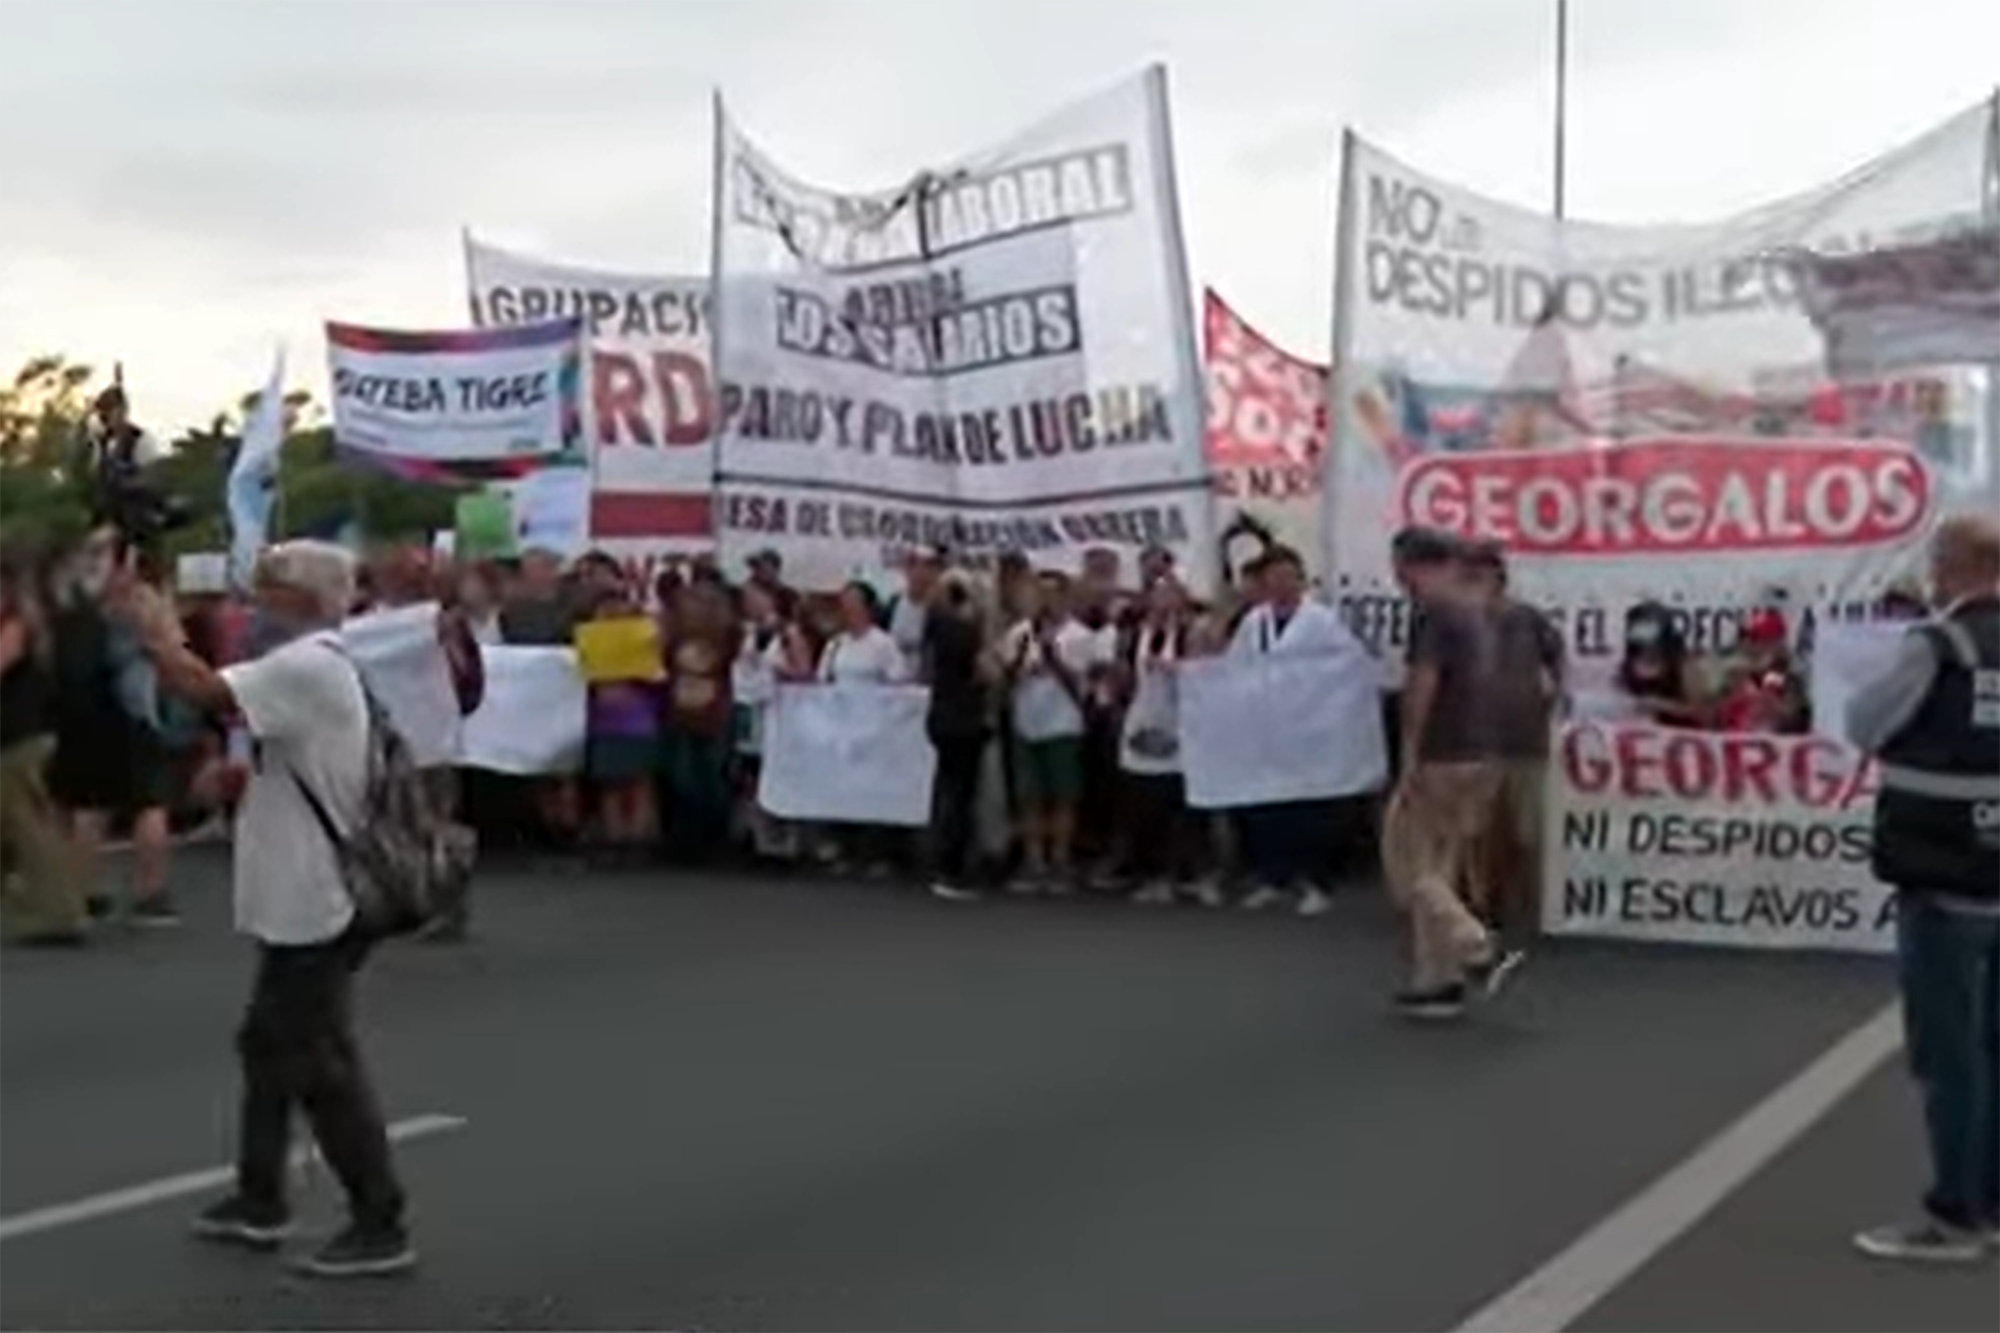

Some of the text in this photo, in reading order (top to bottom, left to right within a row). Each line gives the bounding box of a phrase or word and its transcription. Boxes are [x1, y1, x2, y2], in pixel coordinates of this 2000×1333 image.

[1369, 176, 1440, 244] NO
[1367, 246, 1648, 328] DESPIDOS
[720, 385, 822, 441] PARO
[961, 412, 1007, 466] DE
[1408, 458, 1917, 545] GEORGALOS
[1576, 609, 1611, 654] EL
[1564, 814, 1872, 863] NI DESPIDOS
[1564, 880, 1607, 918] NI
[1620, 879, 1860, 930] ESCLAVOS
